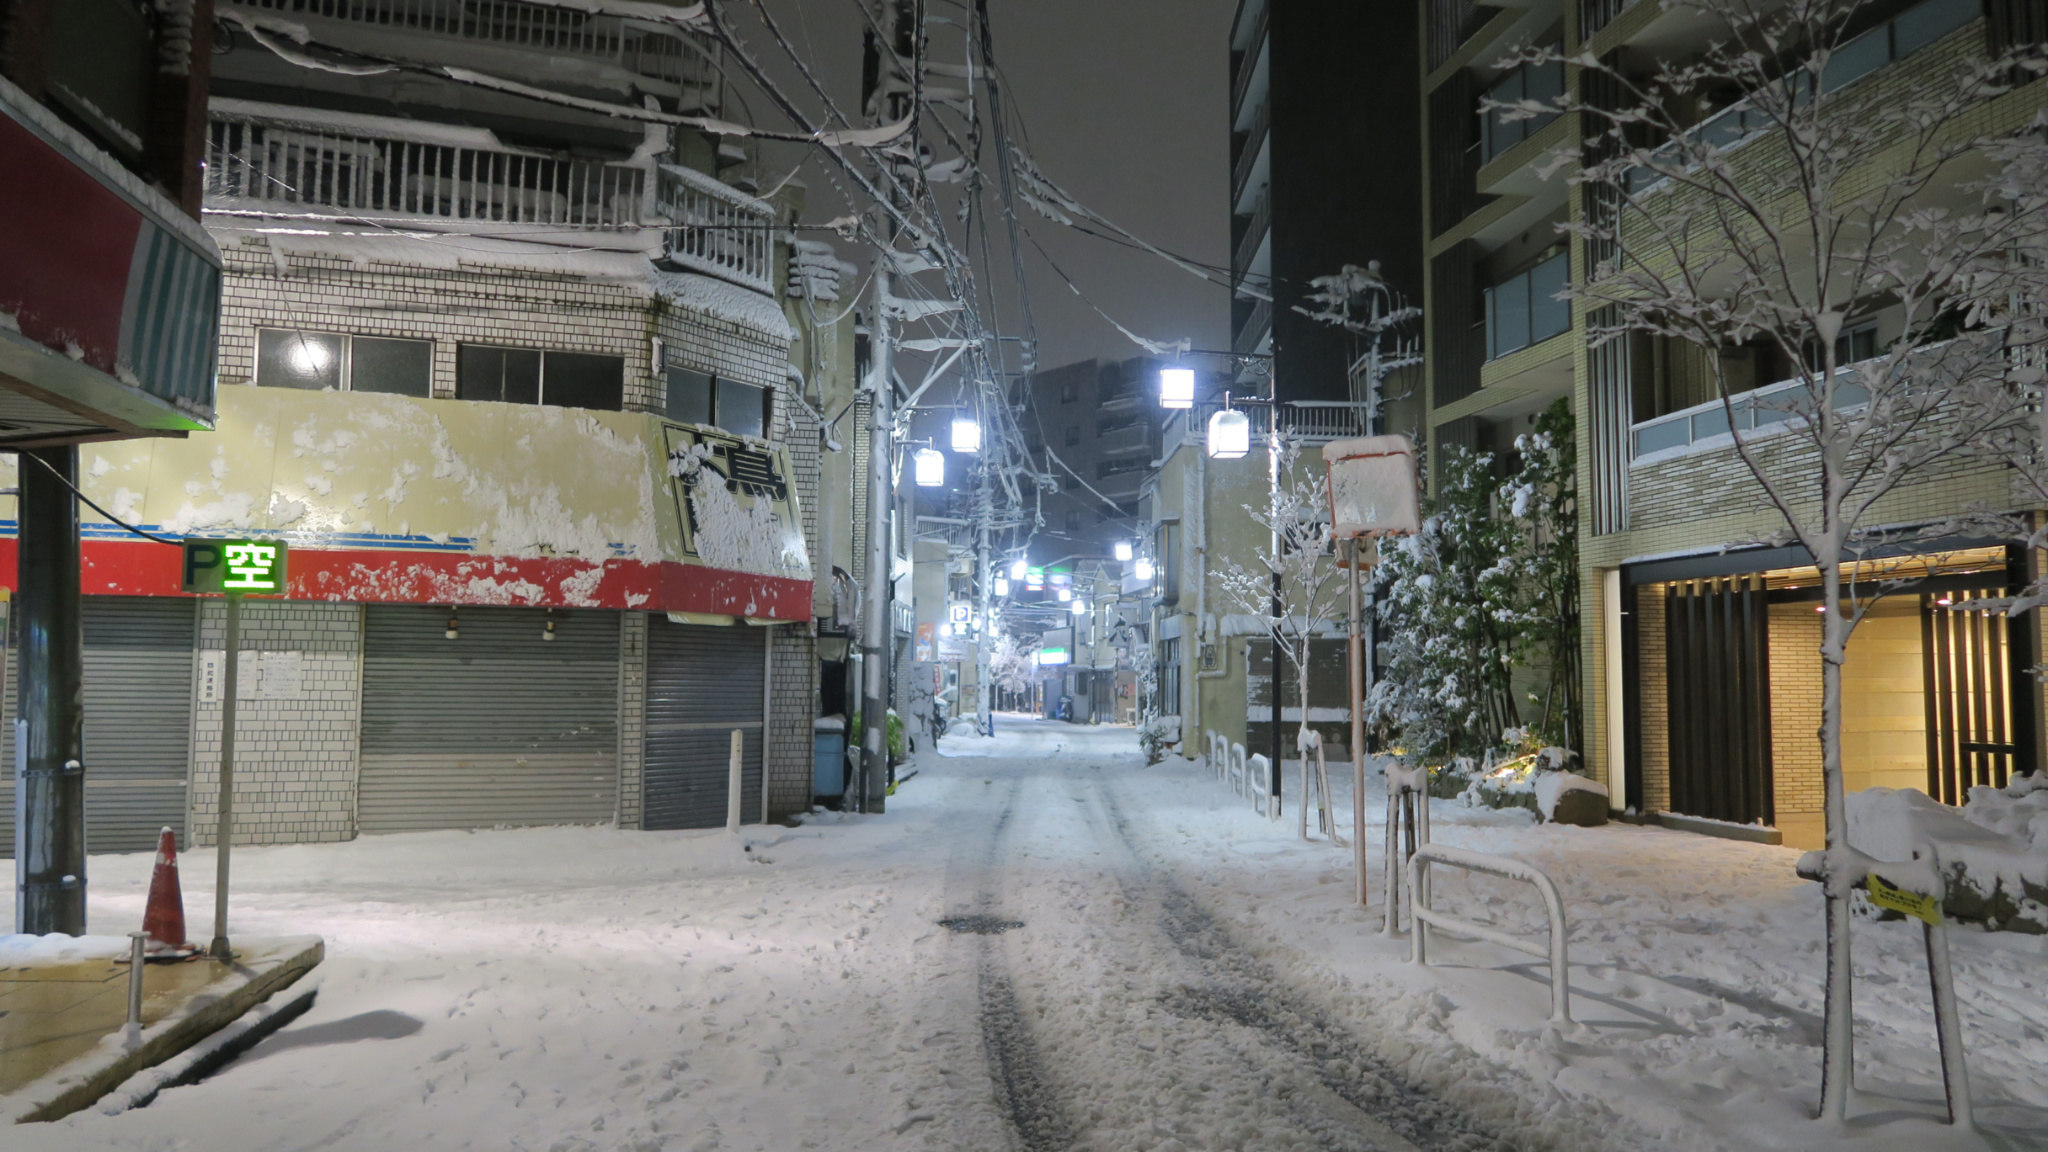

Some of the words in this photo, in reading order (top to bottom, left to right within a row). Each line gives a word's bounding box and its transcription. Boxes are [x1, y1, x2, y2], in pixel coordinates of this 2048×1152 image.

[186, 545, 222, 585] P
[224, 543, 276, 589] 空
[955, 608, 967, 620] P
